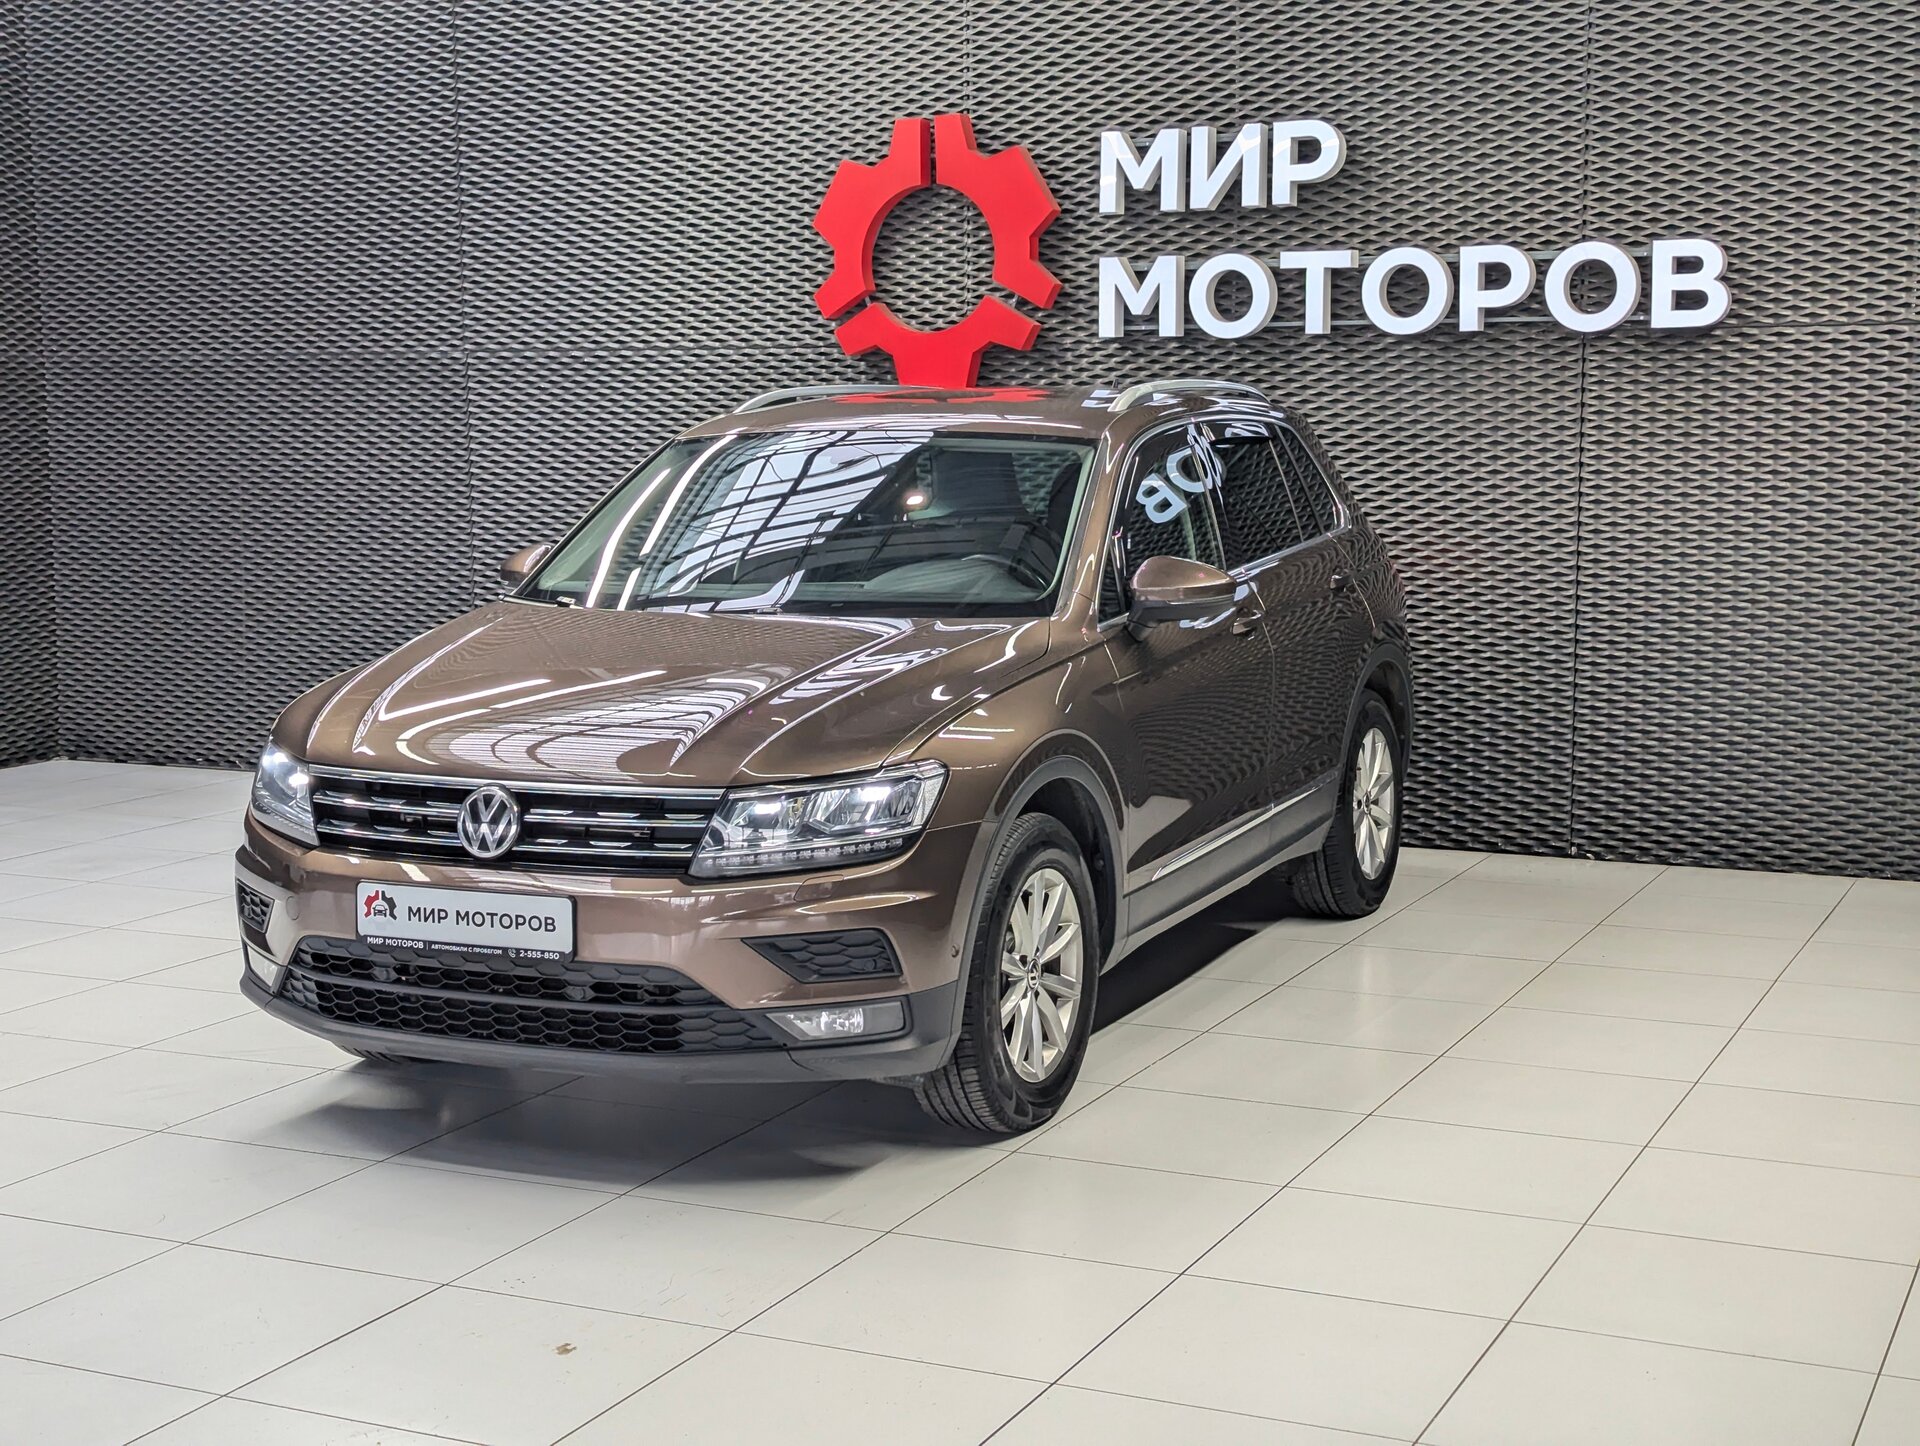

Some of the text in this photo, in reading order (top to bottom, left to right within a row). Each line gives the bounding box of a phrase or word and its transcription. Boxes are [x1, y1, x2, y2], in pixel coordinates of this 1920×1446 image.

[1099, 119, 1347, 215] МИР
[1098, 238, 1732, 340] МОТОРОВ
[366, 936, 384, 945] МИР
[385, 938, 424, 949] МОТОРОВ
[430, 943, 468, 952] АВТОМОБИЛИ
[473, 947, 503, 955] ПРОБЕГОМ
[519, 949, 560, 960] 2-555-850
[407, 905, 557, 933] МИР МОТОРОВ
